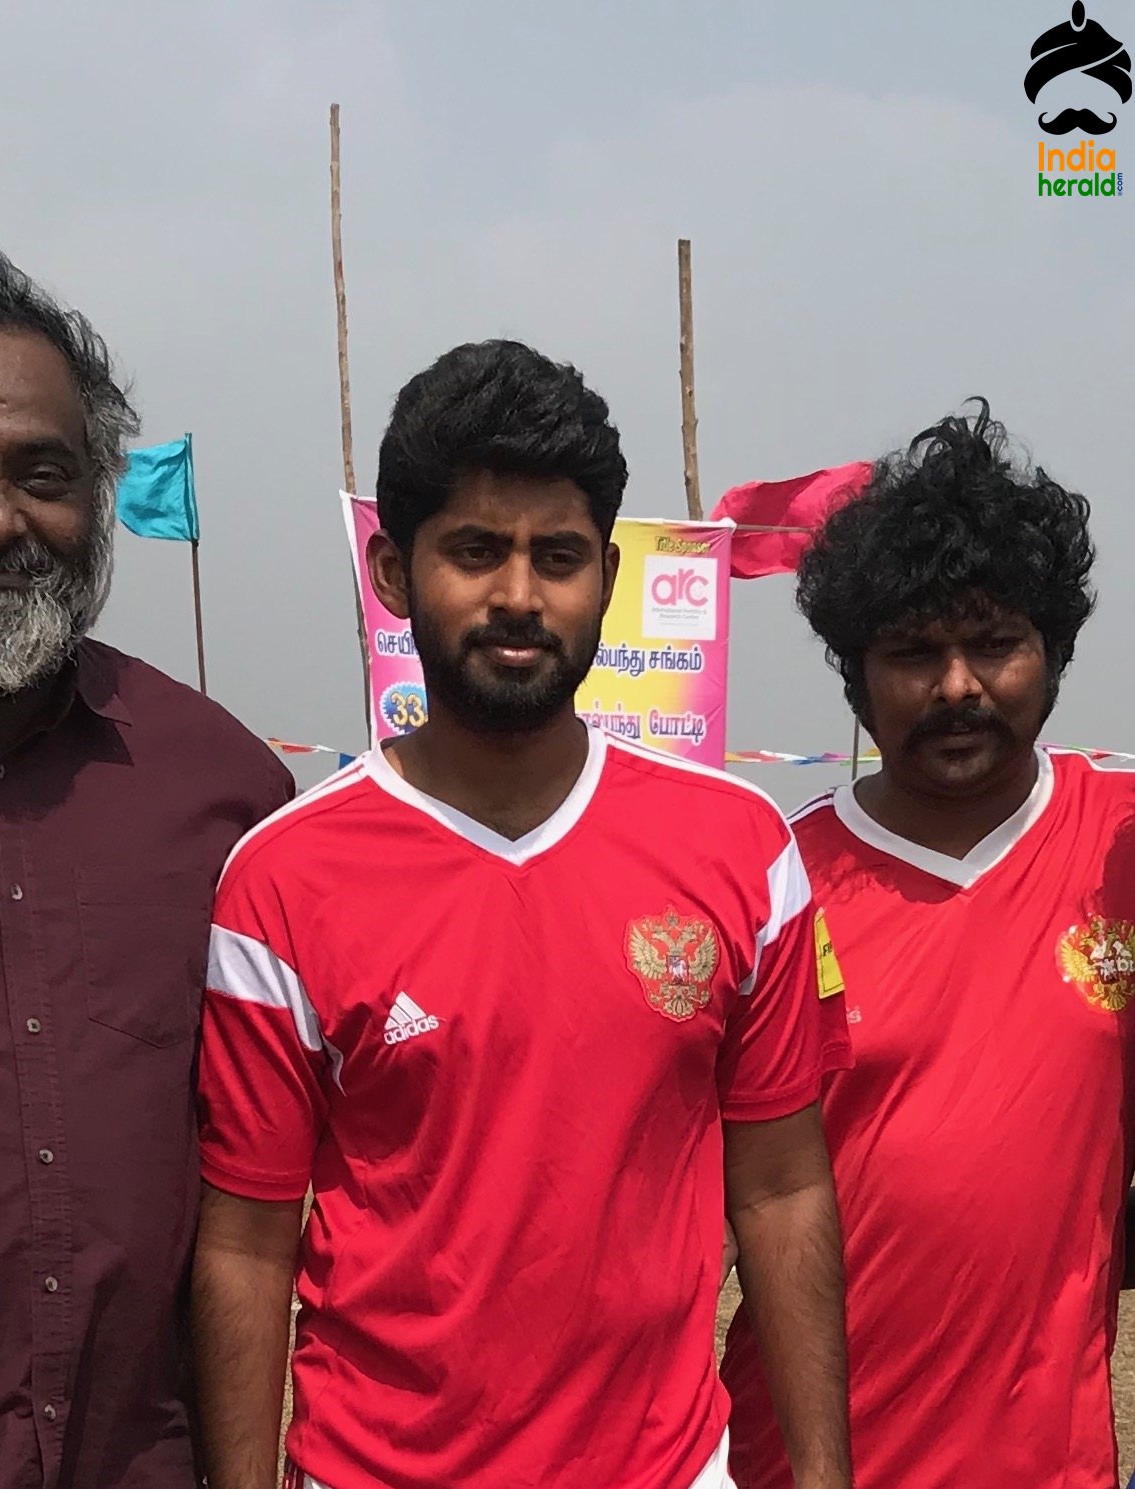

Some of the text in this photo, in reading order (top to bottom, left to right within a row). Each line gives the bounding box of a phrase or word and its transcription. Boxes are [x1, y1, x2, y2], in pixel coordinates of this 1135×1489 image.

[651, 568, 709, 606] arc
[593, 642, 645, 677] ல்பந்து
[649, 645, 702, 670] சங்கம்
[391, 692, 428, 728] 33
[649, 710, 704, 743] போட்டி
[384, 1014, 439, 1045] adidas
